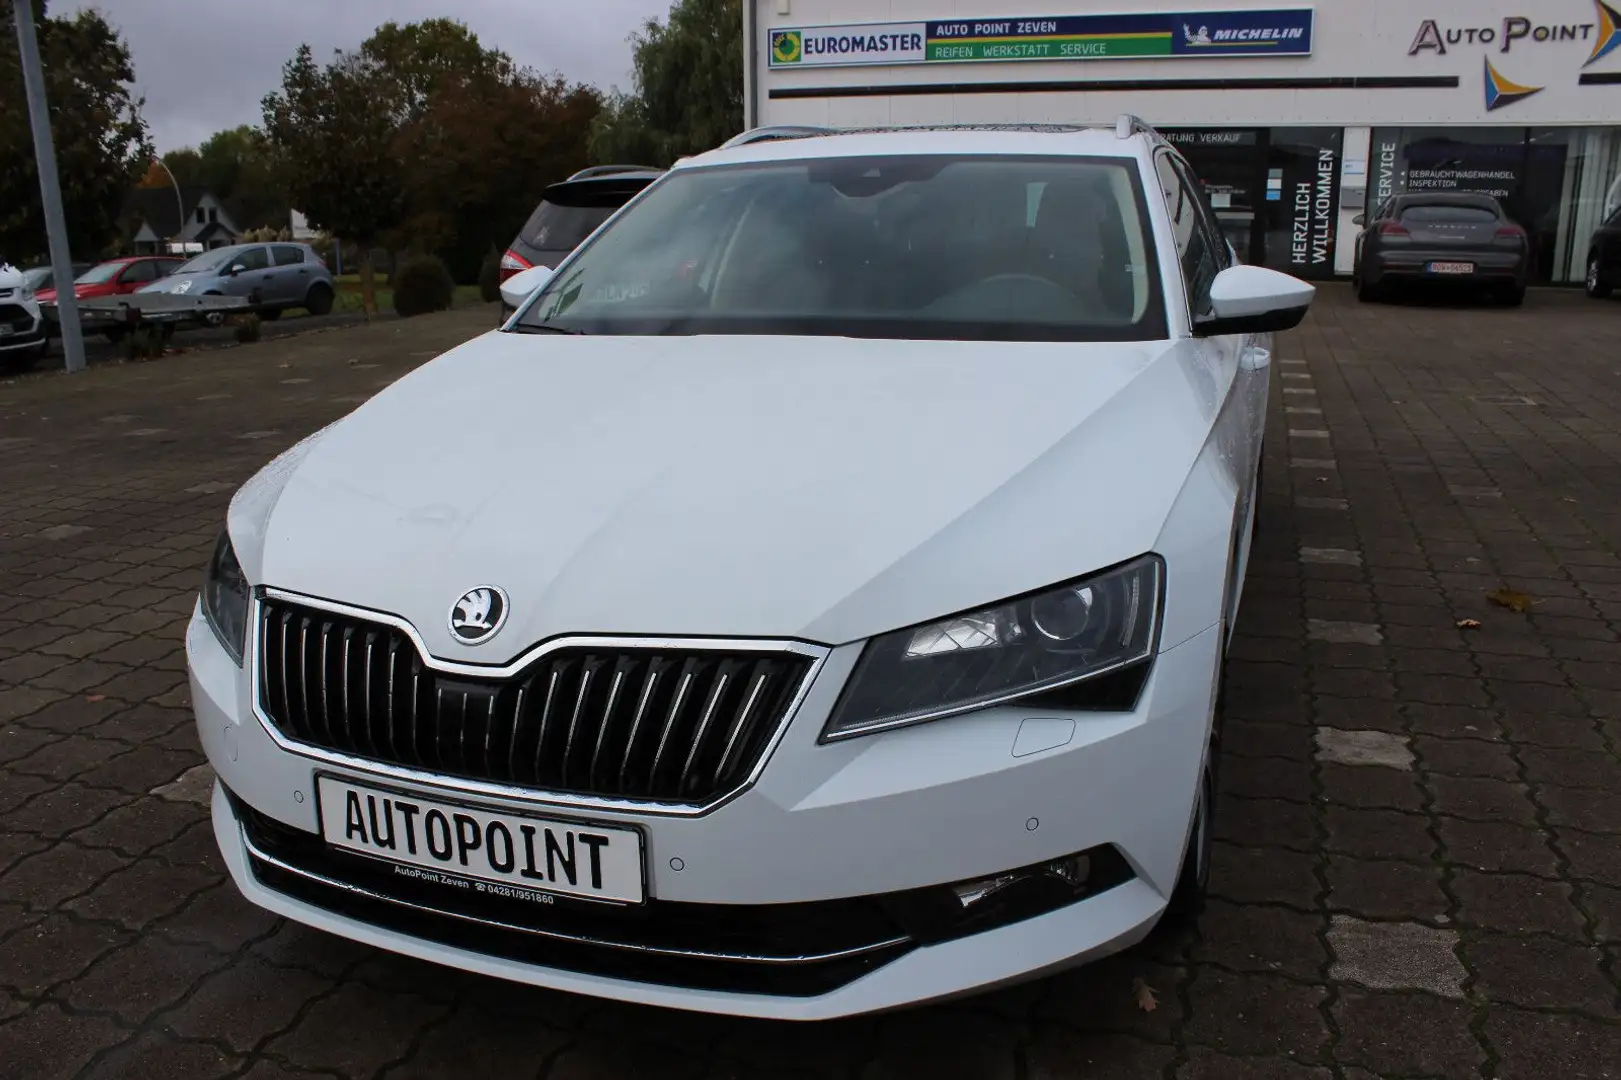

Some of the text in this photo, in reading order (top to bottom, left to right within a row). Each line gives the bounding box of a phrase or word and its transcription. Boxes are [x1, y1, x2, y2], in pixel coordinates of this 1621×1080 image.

[936, 21, 1057, 36] AUTO POINT ZEVEN
[1214, 27, 1303, 40] MICHELIN
[804, 33, 922, 55] EUROMASTER
[935, 43, 1106, 58] REIFEN WERKSTATT SERVICE
[1161, 132, 1241, 143] RATUNG VERKAUF
[1409, 170, 1515, 180] GEBRAUCHTWAGENHANDEL
[1408, 179, 1457, 188] INSPEKTION
[1312, 149, 1334, 264] WILLKOMMEN
[1292, 183, 1311, 264] HERZLICH
[346, 789, 609, 890] AUTOPOINT
[394, 865, 554, 905] AutoPoint Zeven 04281/951860
